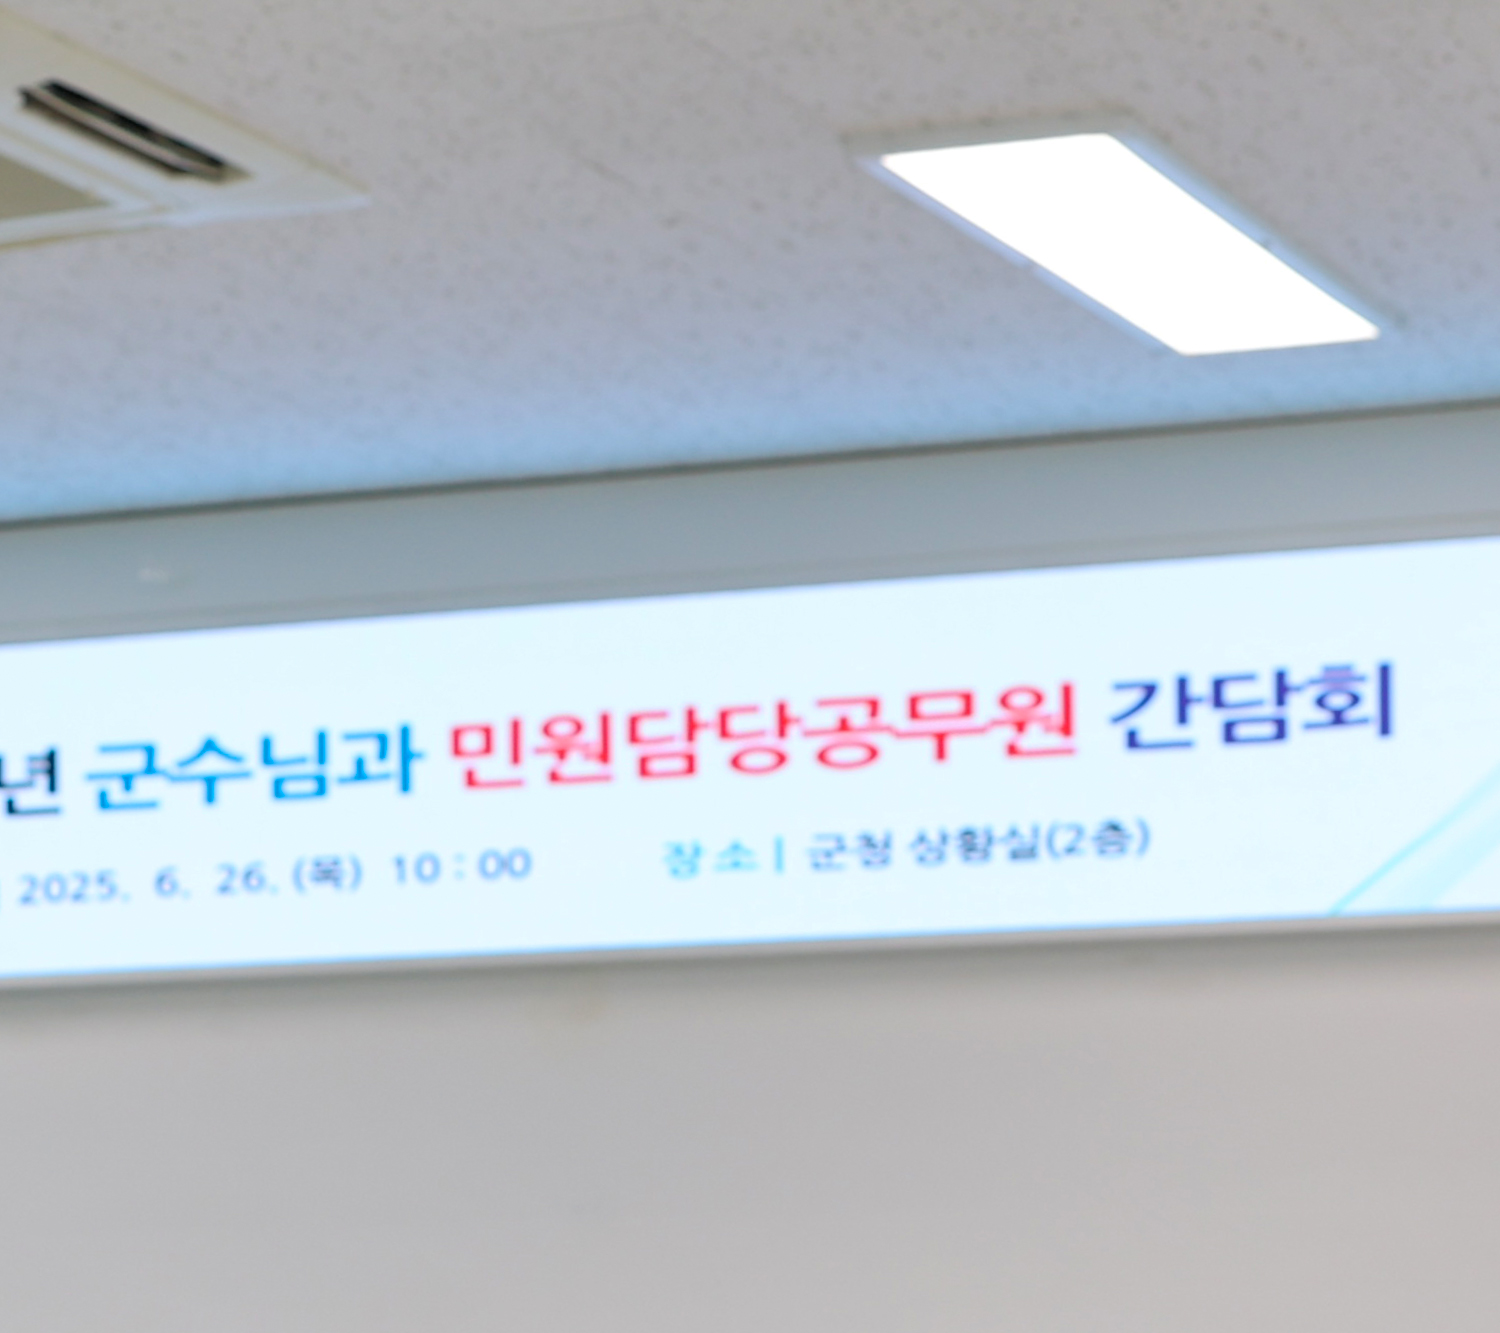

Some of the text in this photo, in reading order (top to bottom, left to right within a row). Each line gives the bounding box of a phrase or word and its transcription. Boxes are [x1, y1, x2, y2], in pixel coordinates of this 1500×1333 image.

[86, 722, 425, 812] 군수님과
[450, 681, 1076, 790] 민원담당공무원
[1109, 660, 1394, 752] 간담회
[807, 830, 894, 872] 군청
[17, 868, 131, 906] 2025.
[153, 865, 190, 899] 6.
